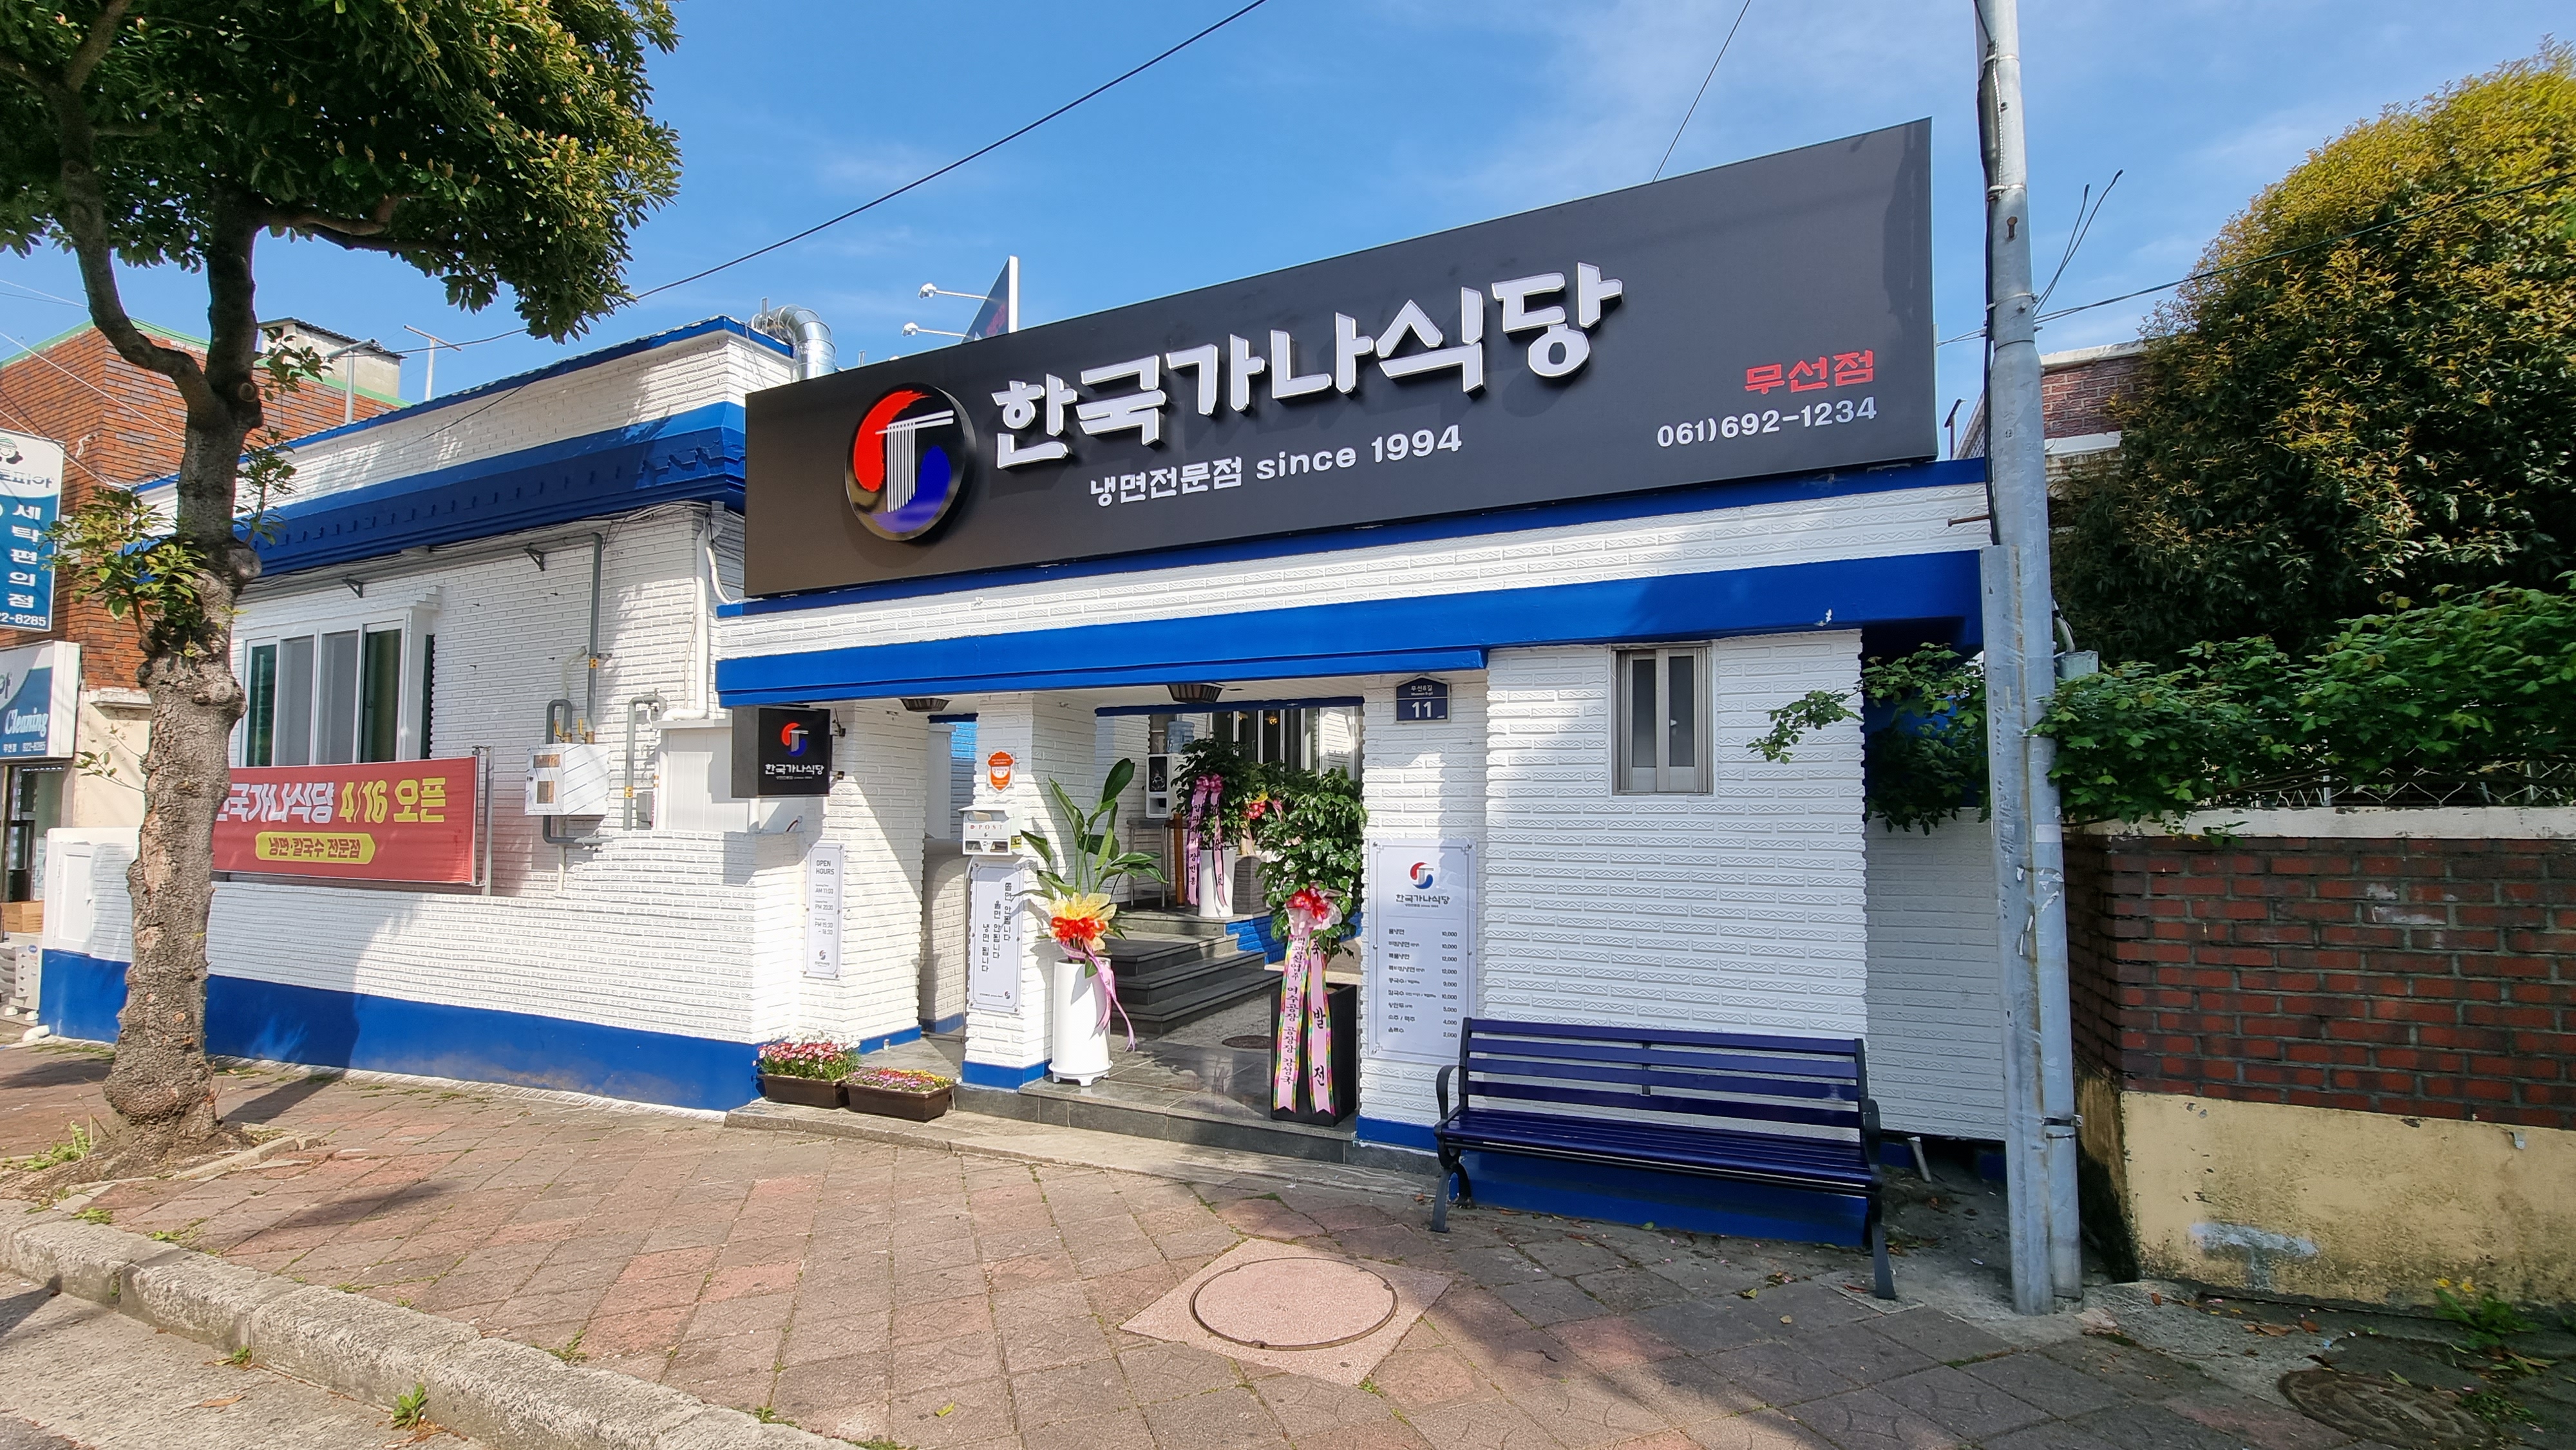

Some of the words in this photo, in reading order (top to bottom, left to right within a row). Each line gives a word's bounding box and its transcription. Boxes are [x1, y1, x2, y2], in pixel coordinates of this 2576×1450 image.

[990, 261, 1624, 469] 한국가나식당
[1744, 349, 1874, 395] 무선점
[1656, 396, 1877, 447] 061)692-1234
[1090, 457, 1242, 507] 냉면전문점
[1256, 446, 1357, 480] since
[1371, 425, 1463, 463] 1994
[8, 504, 43, 608] 세탁편의점
[0, 612, 46, 626] 2-8285
[5, 707, 49, 738] Cleaning
[1412, 701, 1432, 718] 11
[764, 764, 824, 775] 한국가나식당
[339, 779, 388, 824] 4/16
[393, 777, 446, 824] 오픈
[327, 838, 361, 858] 전문점
[1396, 894, 1450, 905] 한국가나식당
[983, 923, 990, 943] 냉면
[992, 923, 1001, 959] 안됩니다
[1003, 905, 1012, 941] 안됩니다
